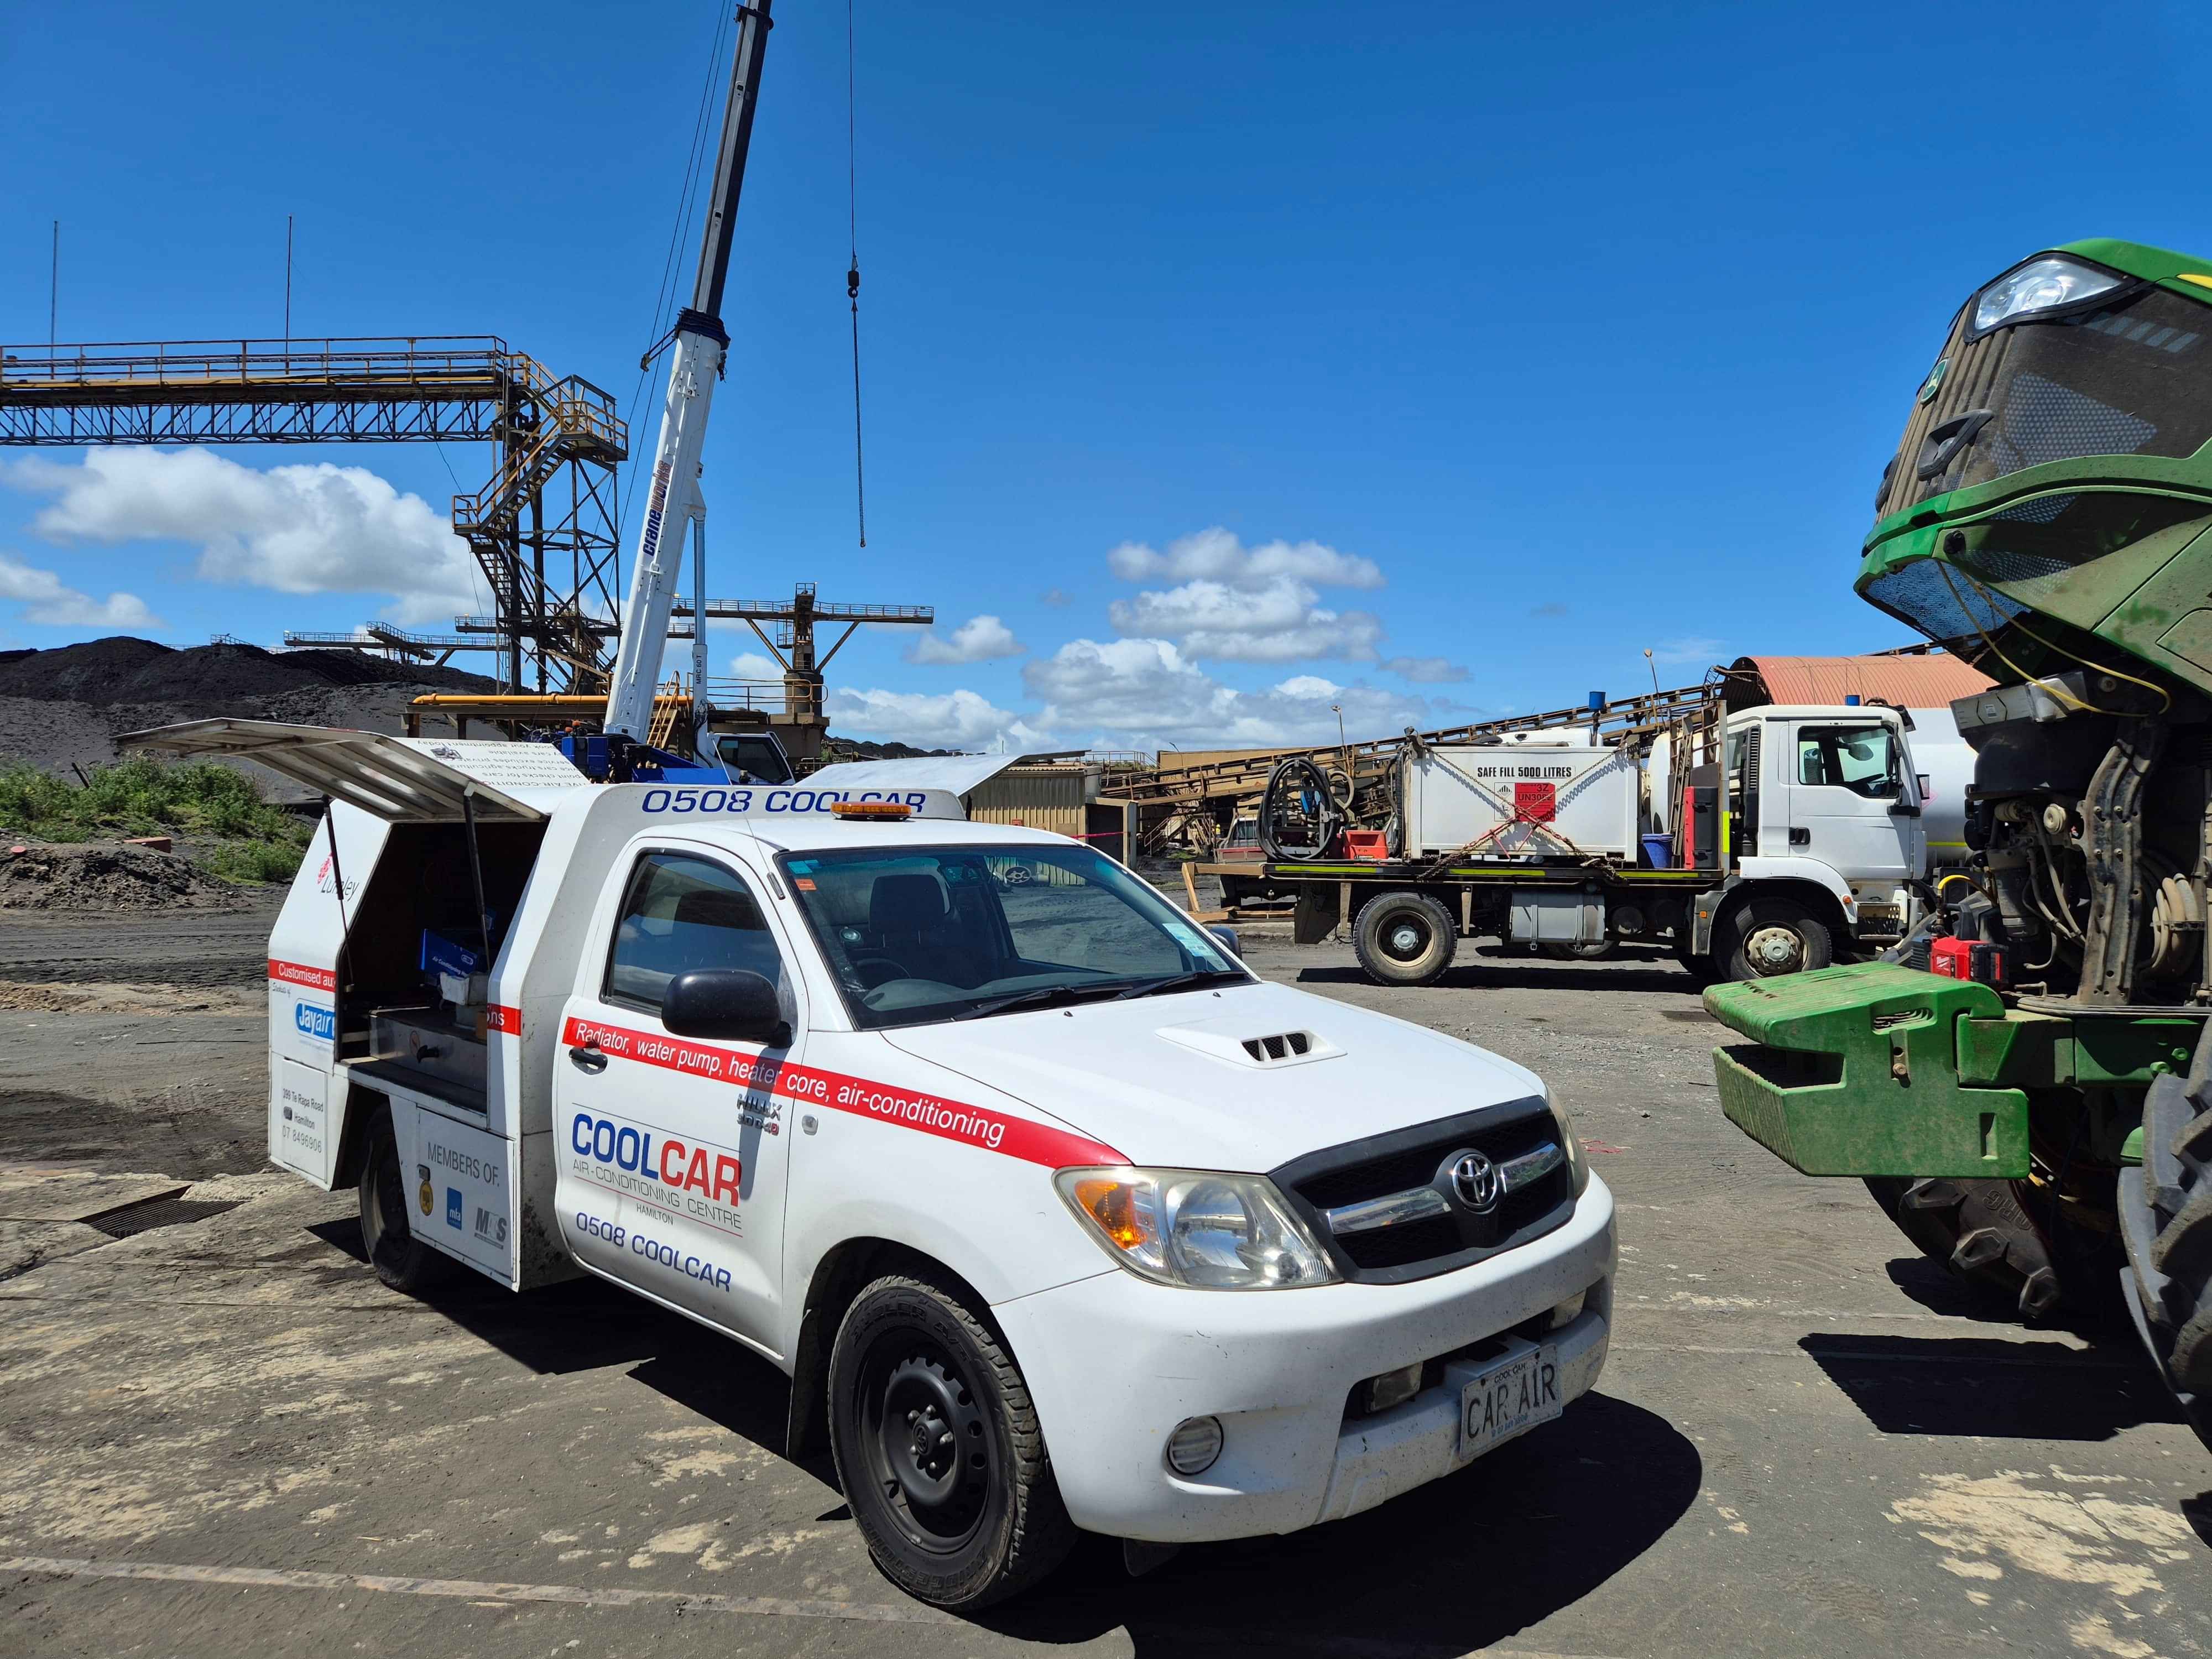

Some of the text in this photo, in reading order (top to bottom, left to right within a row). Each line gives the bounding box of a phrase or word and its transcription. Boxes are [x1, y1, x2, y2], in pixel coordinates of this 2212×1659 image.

[643, 460, 672, 556] craneworks
[1477, 766, 1572, 778] SAFE FILL 5000 LITRES
[642, 789, 752, 812] 0508
[278, 963, 322, 984] Customised
[299, 1003, 331, 1035] Jayair
[576, 1022, 1006, 1149] Radiator, water pump, heater core, air-conditioning
[292, 1091, 297, 1103] Te
[298, 1093, 310, 1108] Rapa
[311, 1098, 324, 1113] Road
[737, 1093, 782, 1121] HILUX
[294, 1111, 315, 1129] Hamilton
[282, 1125, 322, 1153] 07 8496906
[427, 1142, 481, 1180] MEMBERS
[572, 1113, 743, 1207] COOLCAR
[636, 1203, 674, 1226] HAMILTON
[687, 1198, 742, 1230] CENTRE
[576, 1211, 732, 1293] 0508 COOLCAR
[1467, 1363, 1556, 1439] CAR AIR
